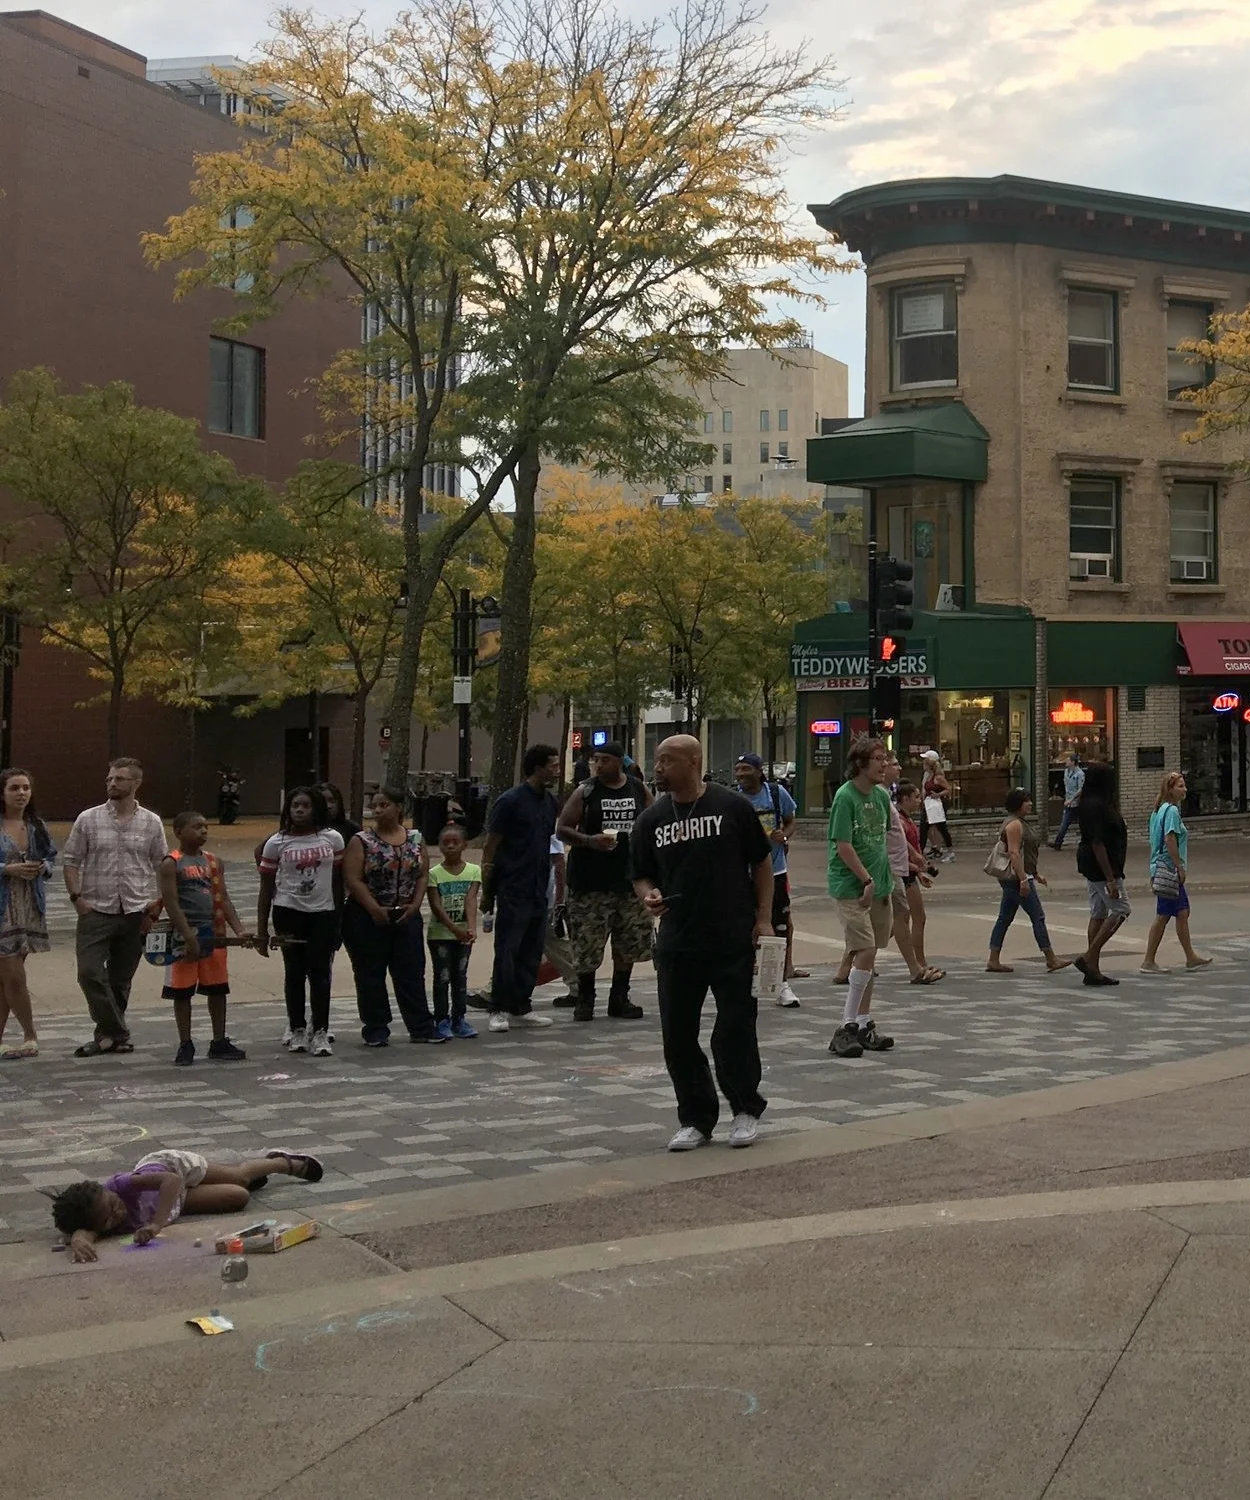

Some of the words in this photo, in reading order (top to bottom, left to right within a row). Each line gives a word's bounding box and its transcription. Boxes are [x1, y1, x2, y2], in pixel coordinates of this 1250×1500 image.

[1214, 697, 1239, 709] ATM
[811, 722, 839, 732] OPEN
[602, 800, 634, 808] BLACK
[603, 811, 634, 820] LIVES
[655, 815, 723, 848] SECURITY
